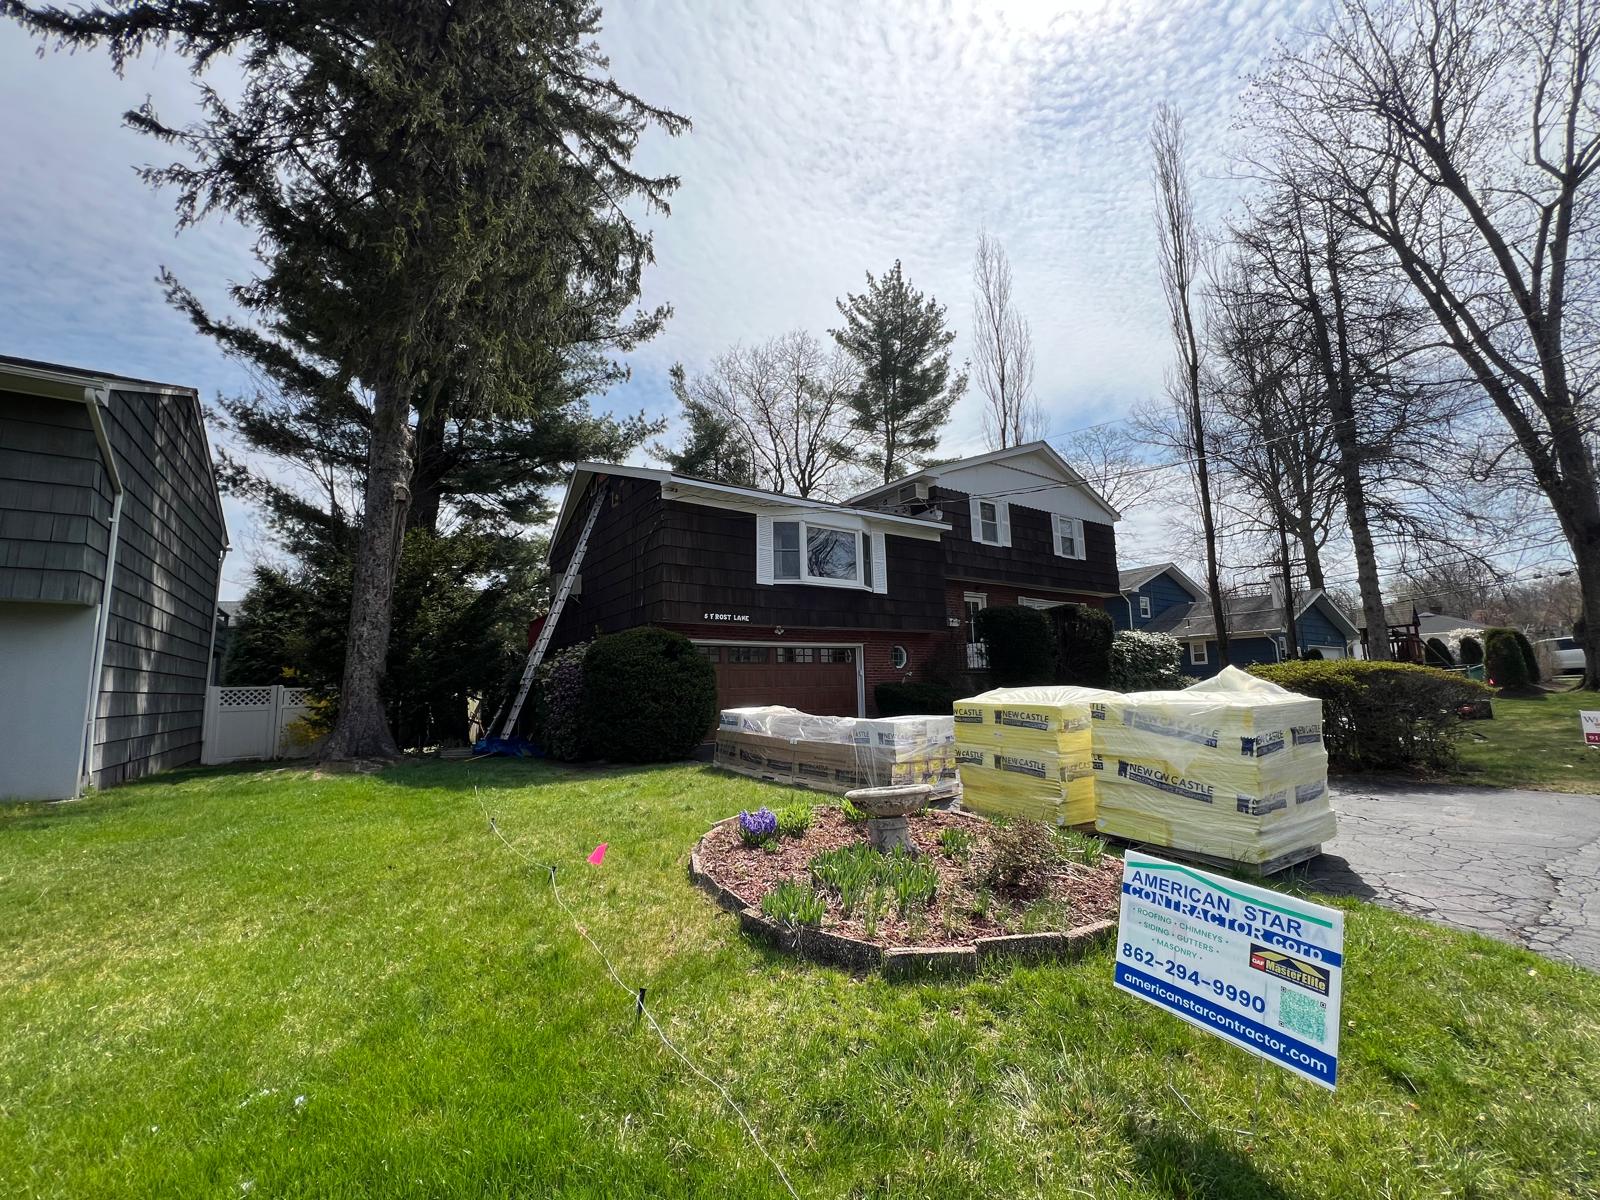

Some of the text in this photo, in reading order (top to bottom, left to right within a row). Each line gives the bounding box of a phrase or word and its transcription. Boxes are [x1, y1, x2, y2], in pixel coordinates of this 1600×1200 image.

[710, 613, 731, 621] FROST
[1171, 775, 1214, 795] CASTLE
[1130, 885, 1265, 941] CONTRACTOR
[1132, 870, 1302, 937] AMERICAN STAR
[1137, 907, 1223, 943] ROOFING CHIMNEYS
[1143, 921, 1214, 953] SIDING GUTTERS
[1156, 938, 1198, 959] MASONRY
[1122, 942, 1266, 1014] 862-294-9990
[1124, 971, 1328, 1074] americanstarcontractor.com
